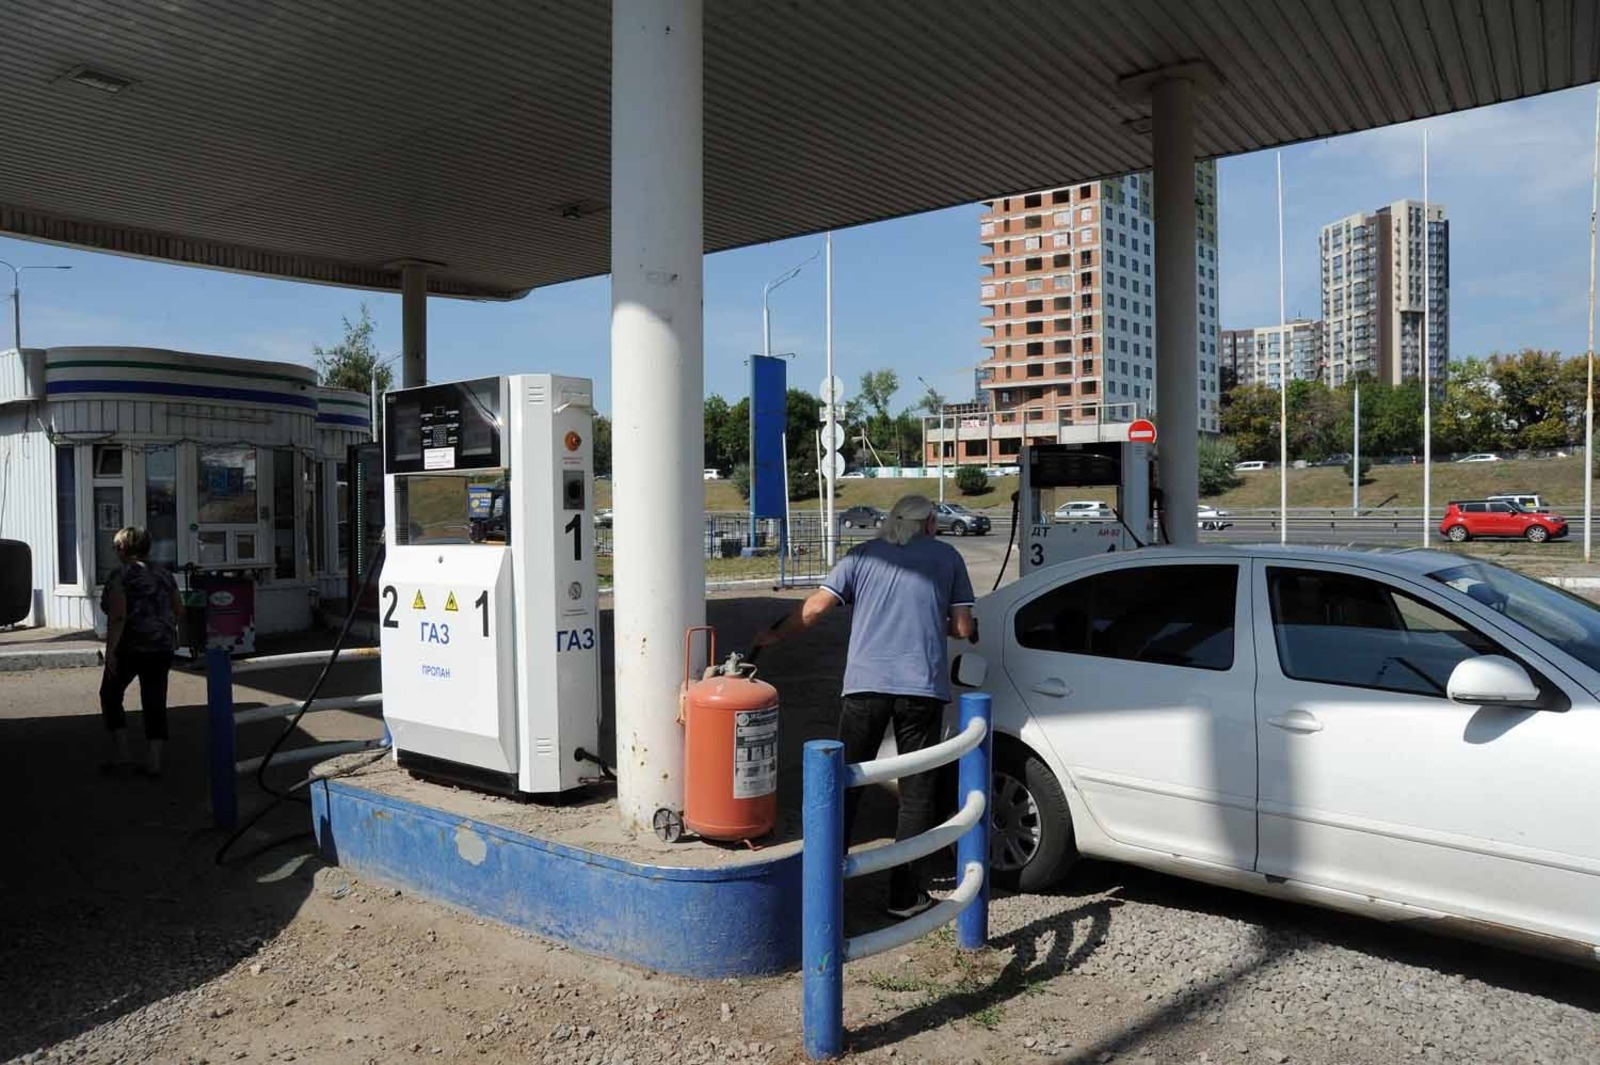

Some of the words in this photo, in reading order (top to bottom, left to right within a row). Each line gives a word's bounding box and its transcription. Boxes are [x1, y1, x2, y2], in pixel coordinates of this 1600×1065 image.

[565, 513, 582, 561] 1
[1032, 526, 1050, 538] ДТ
[1030, 543, 1045, 566] 3
[382, 585, 399, 628] 2
[475, 590, 489, 637] 1
[421, 622, 450, 645] ГАЗ
[557, 628, 594, 652] ГАЗ
[421, 664, 450, 679] ПРОПАН
